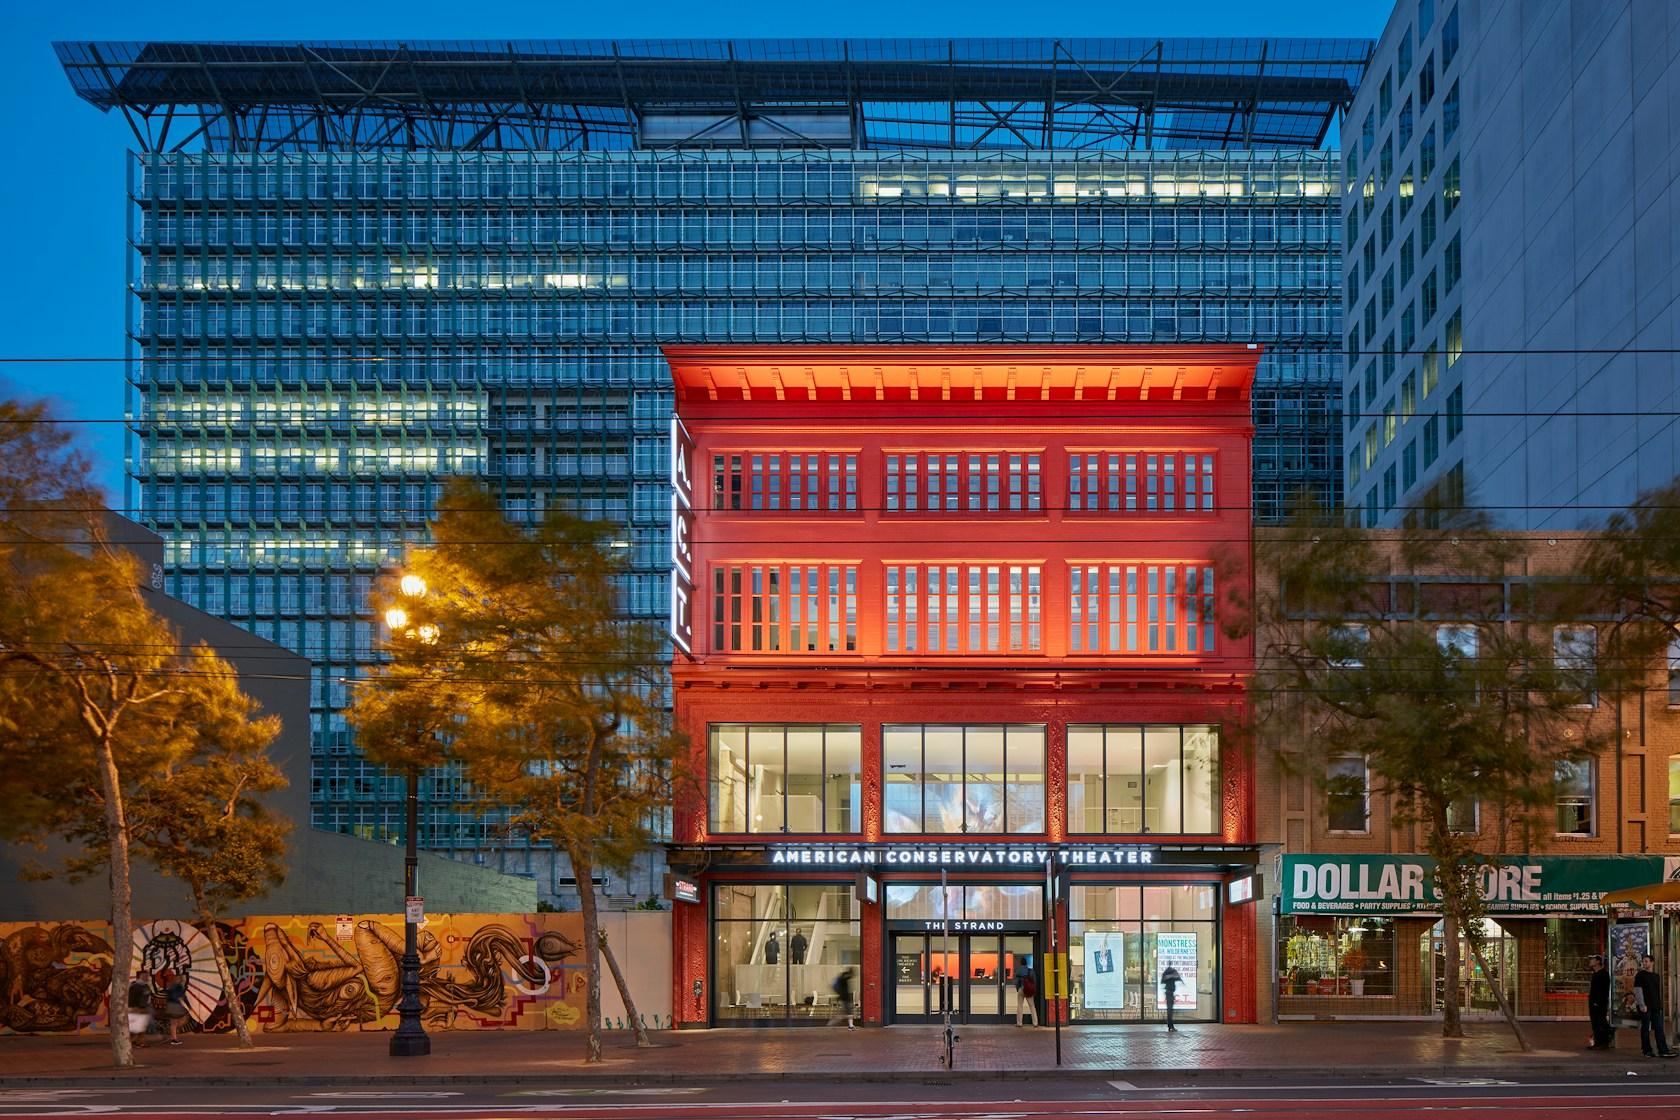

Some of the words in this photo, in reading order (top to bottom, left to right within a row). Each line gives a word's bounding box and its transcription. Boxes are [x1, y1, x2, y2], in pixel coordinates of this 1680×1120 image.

[772, 850, 876, 864] AMERICAN
[885, 850, 1047, 864] CONSERVATORY
[1059, 850, 1152, 864] THEATER
[1293, 863, 1424, 900] DOLLAR
[1432, 864, 1542, 900] ORE
[1542, 892, 1552, 900] all
[1591, 892, 1598, 900] &
[1292, 902, 1310, 910] FOOD
[1311, 902, 1317, 910] &
[1317, 902, 1355, 910] BEVERAGES
[1359, 902, 1381, 910] PARTY
[1381, 902, 1411, 910] SUPPLIES
[1510, 903, 1540, 911] SUPPLIES
[1545, 903, 1568, 911] SCHOOL
[1569, 903, 1599, 911] SUPPLIES
[954, 921, 1004, 930] STRAND
